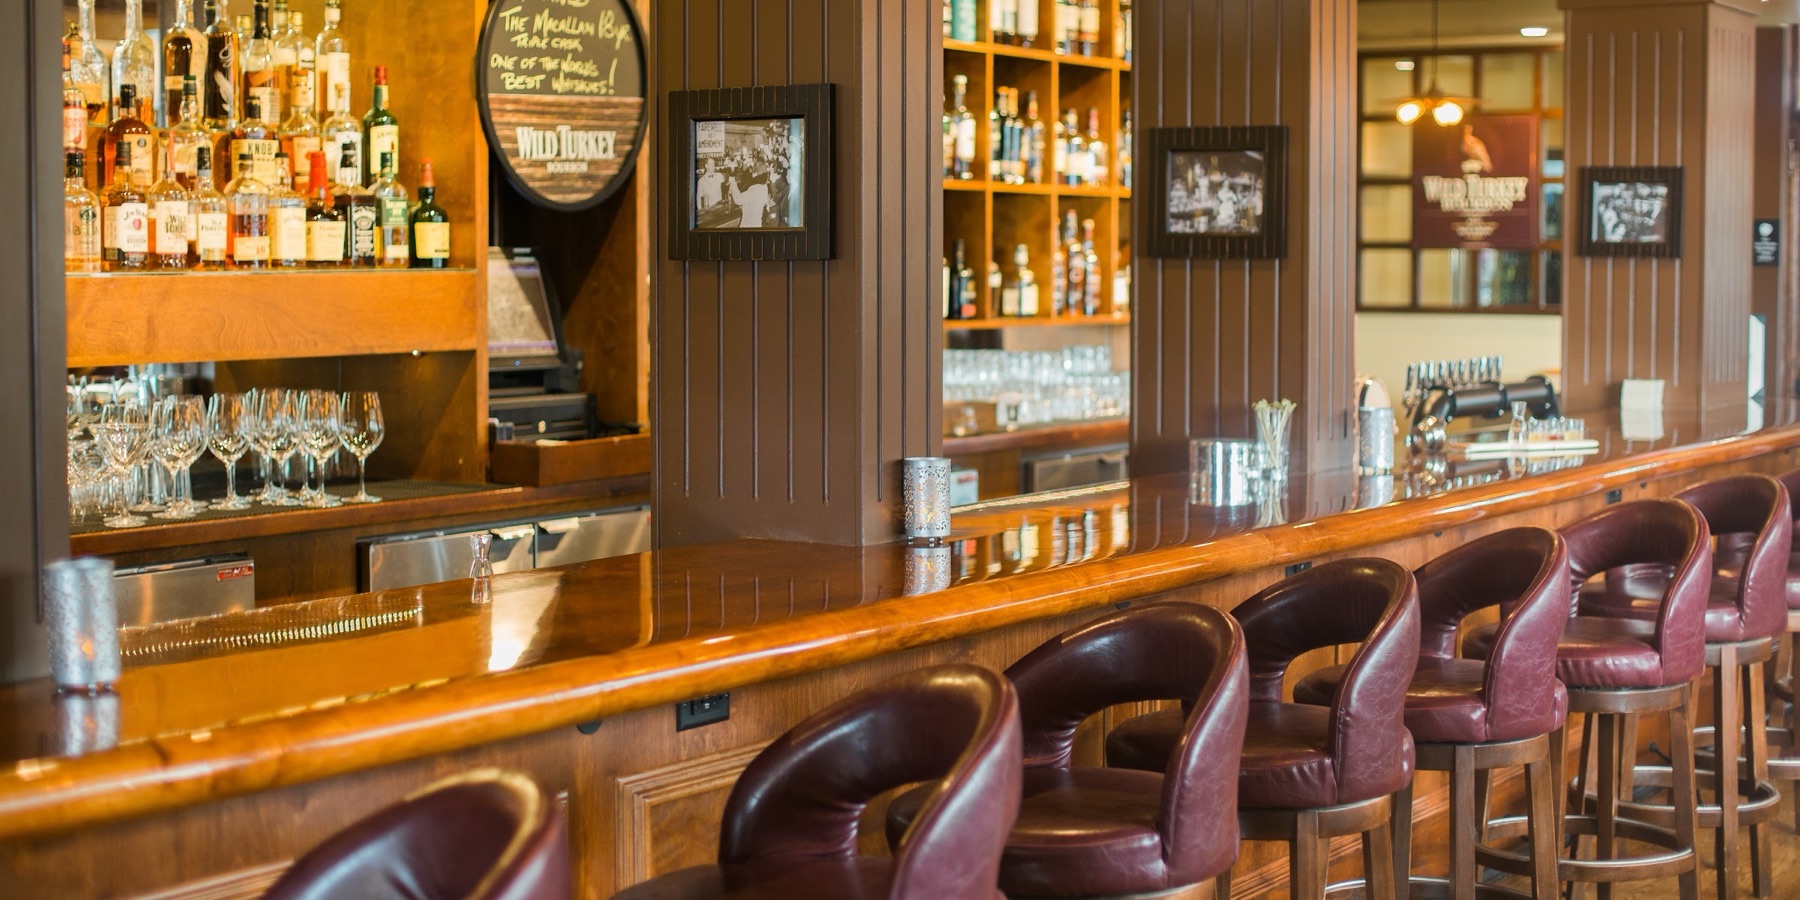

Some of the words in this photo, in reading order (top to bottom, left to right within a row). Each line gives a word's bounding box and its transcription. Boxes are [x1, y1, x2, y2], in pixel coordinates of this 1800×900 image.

[499, 6, 529, 32] THE
[490, 53, 518, 71] ONE
[520, 56, 538, 70] OF
[539, 56, 560, 72] THE
[501, 72, 546, 90] BEST
[247, 142, 273, 155] KNOB
[516, 126, 558, 160] WILD
[556, 125, 616, 160] TURKEY
